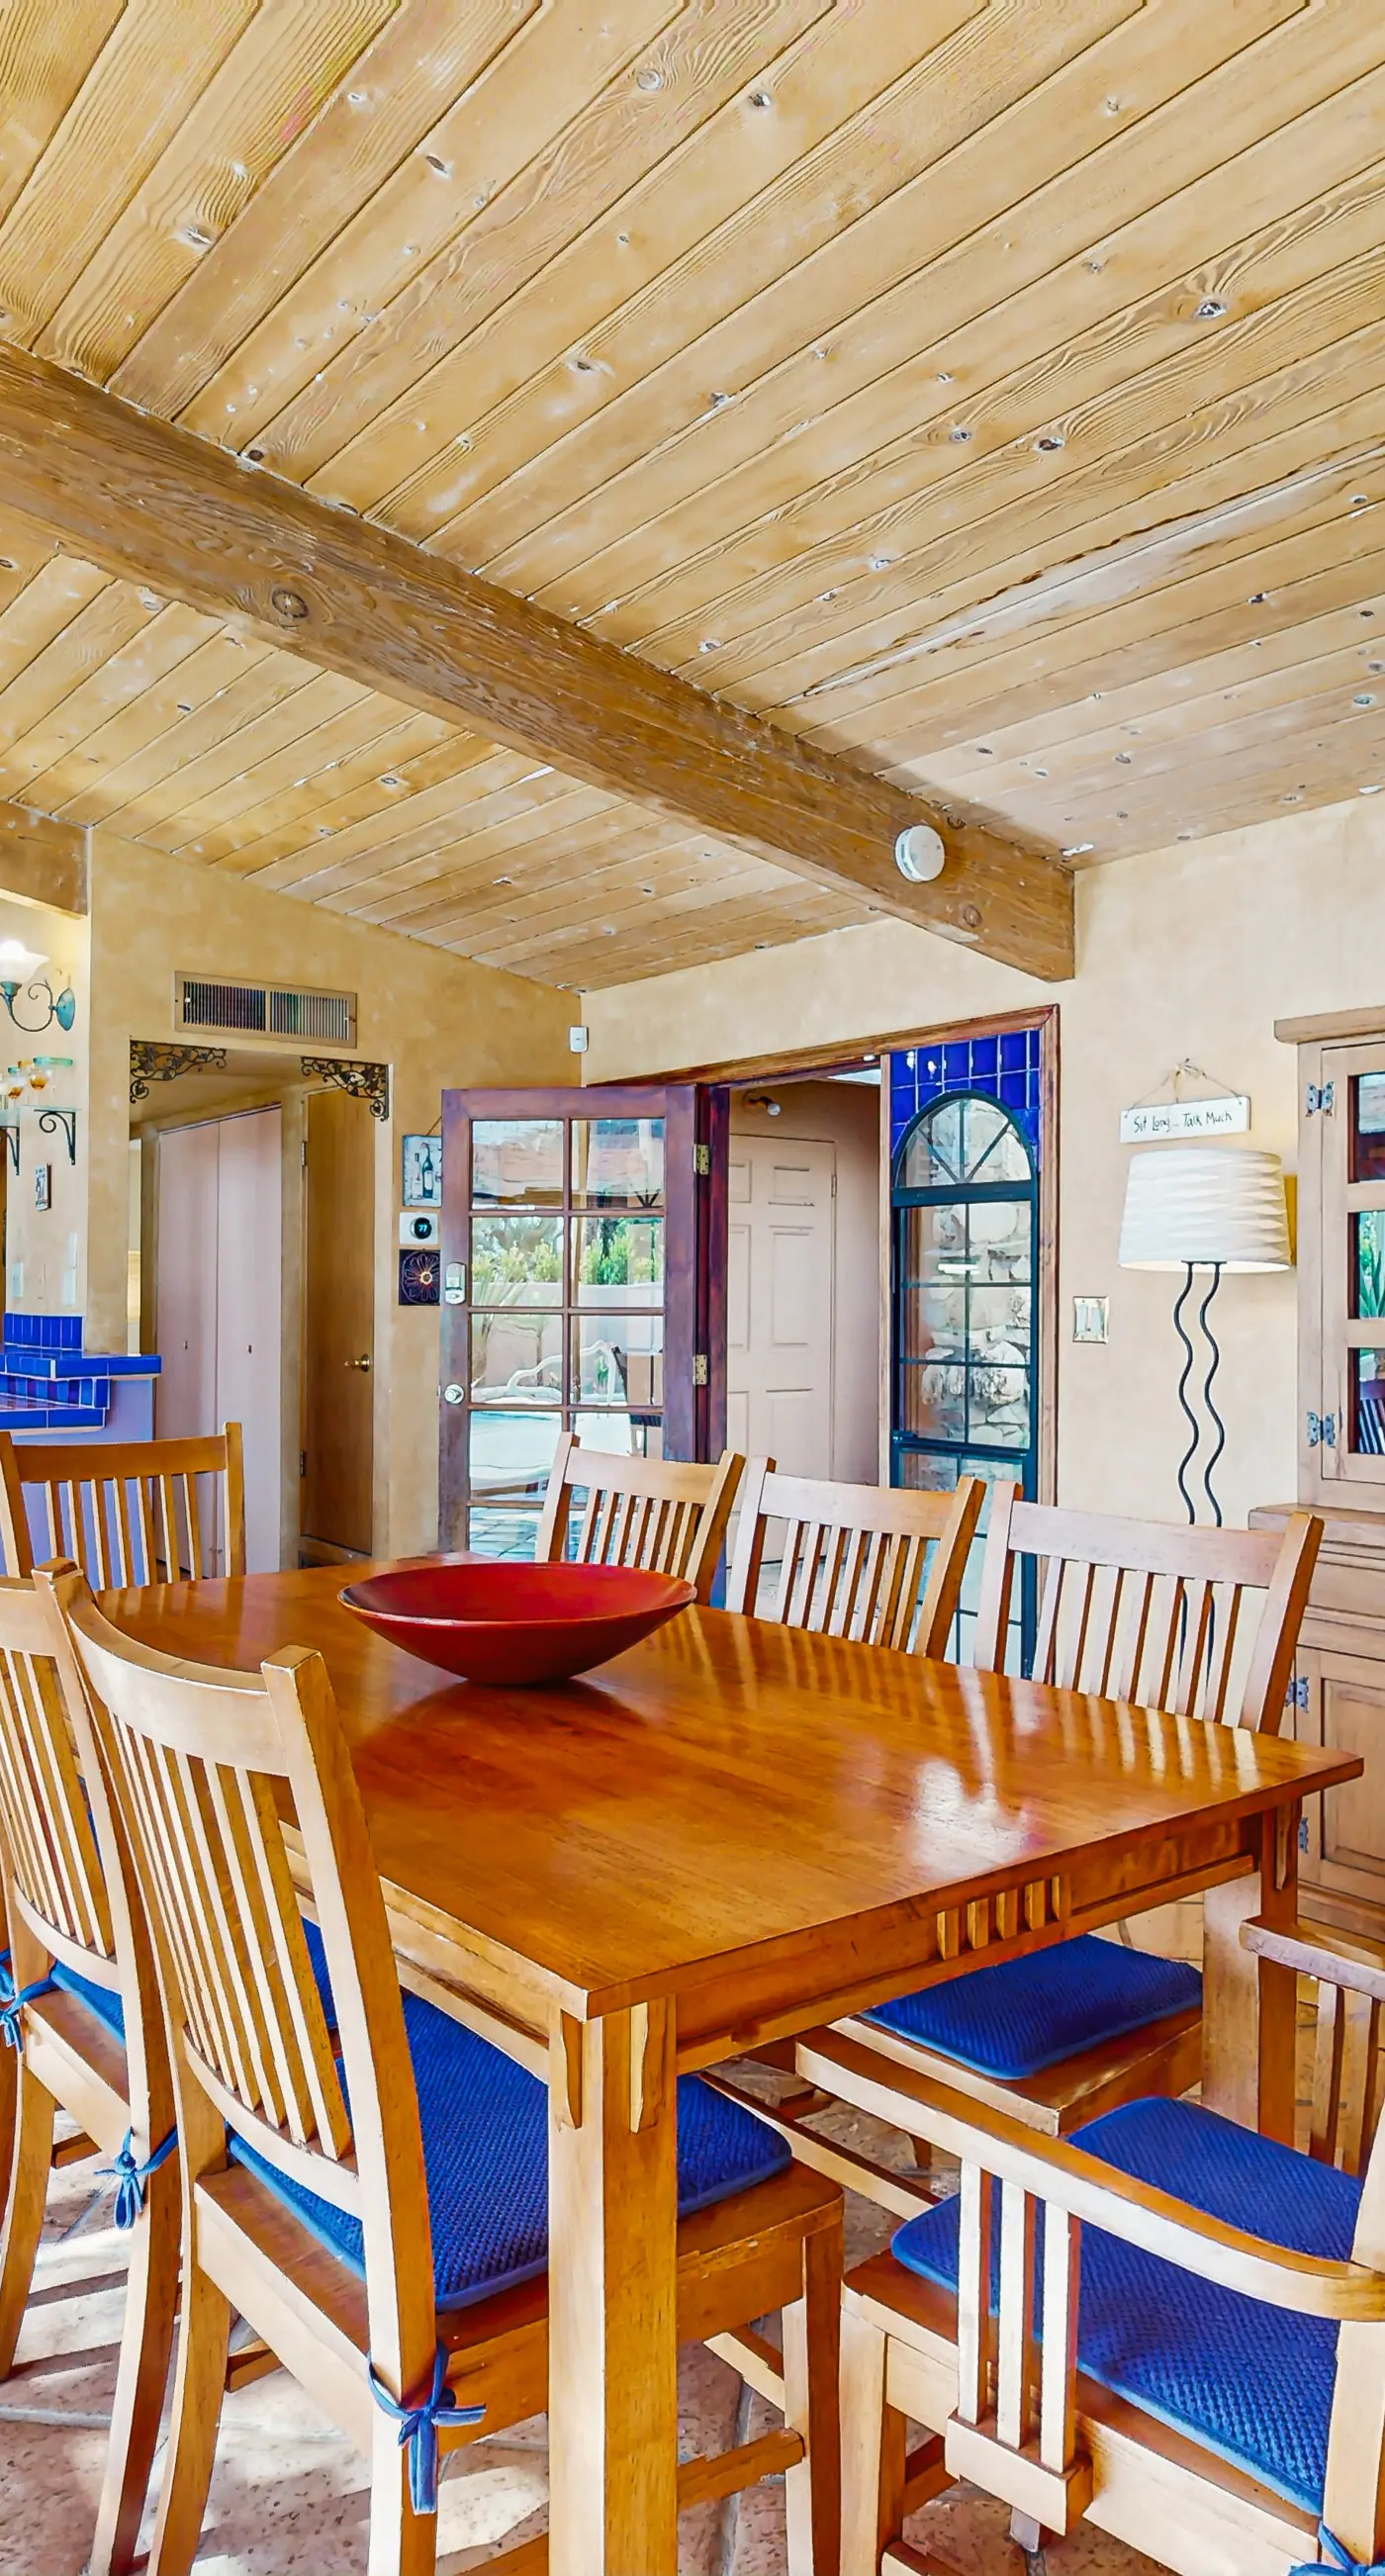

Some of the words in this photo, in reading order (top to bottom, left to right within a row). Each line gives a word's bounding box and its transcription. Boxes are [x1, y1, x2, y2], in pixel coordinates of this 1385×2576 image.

[1133, 1116, 1148, 1133] Sit
[1182, 1113, 1203, 1127] Talk
[1206, 1110, 1233, 1125] Much
[418, 1224, 427, 1233] 77
